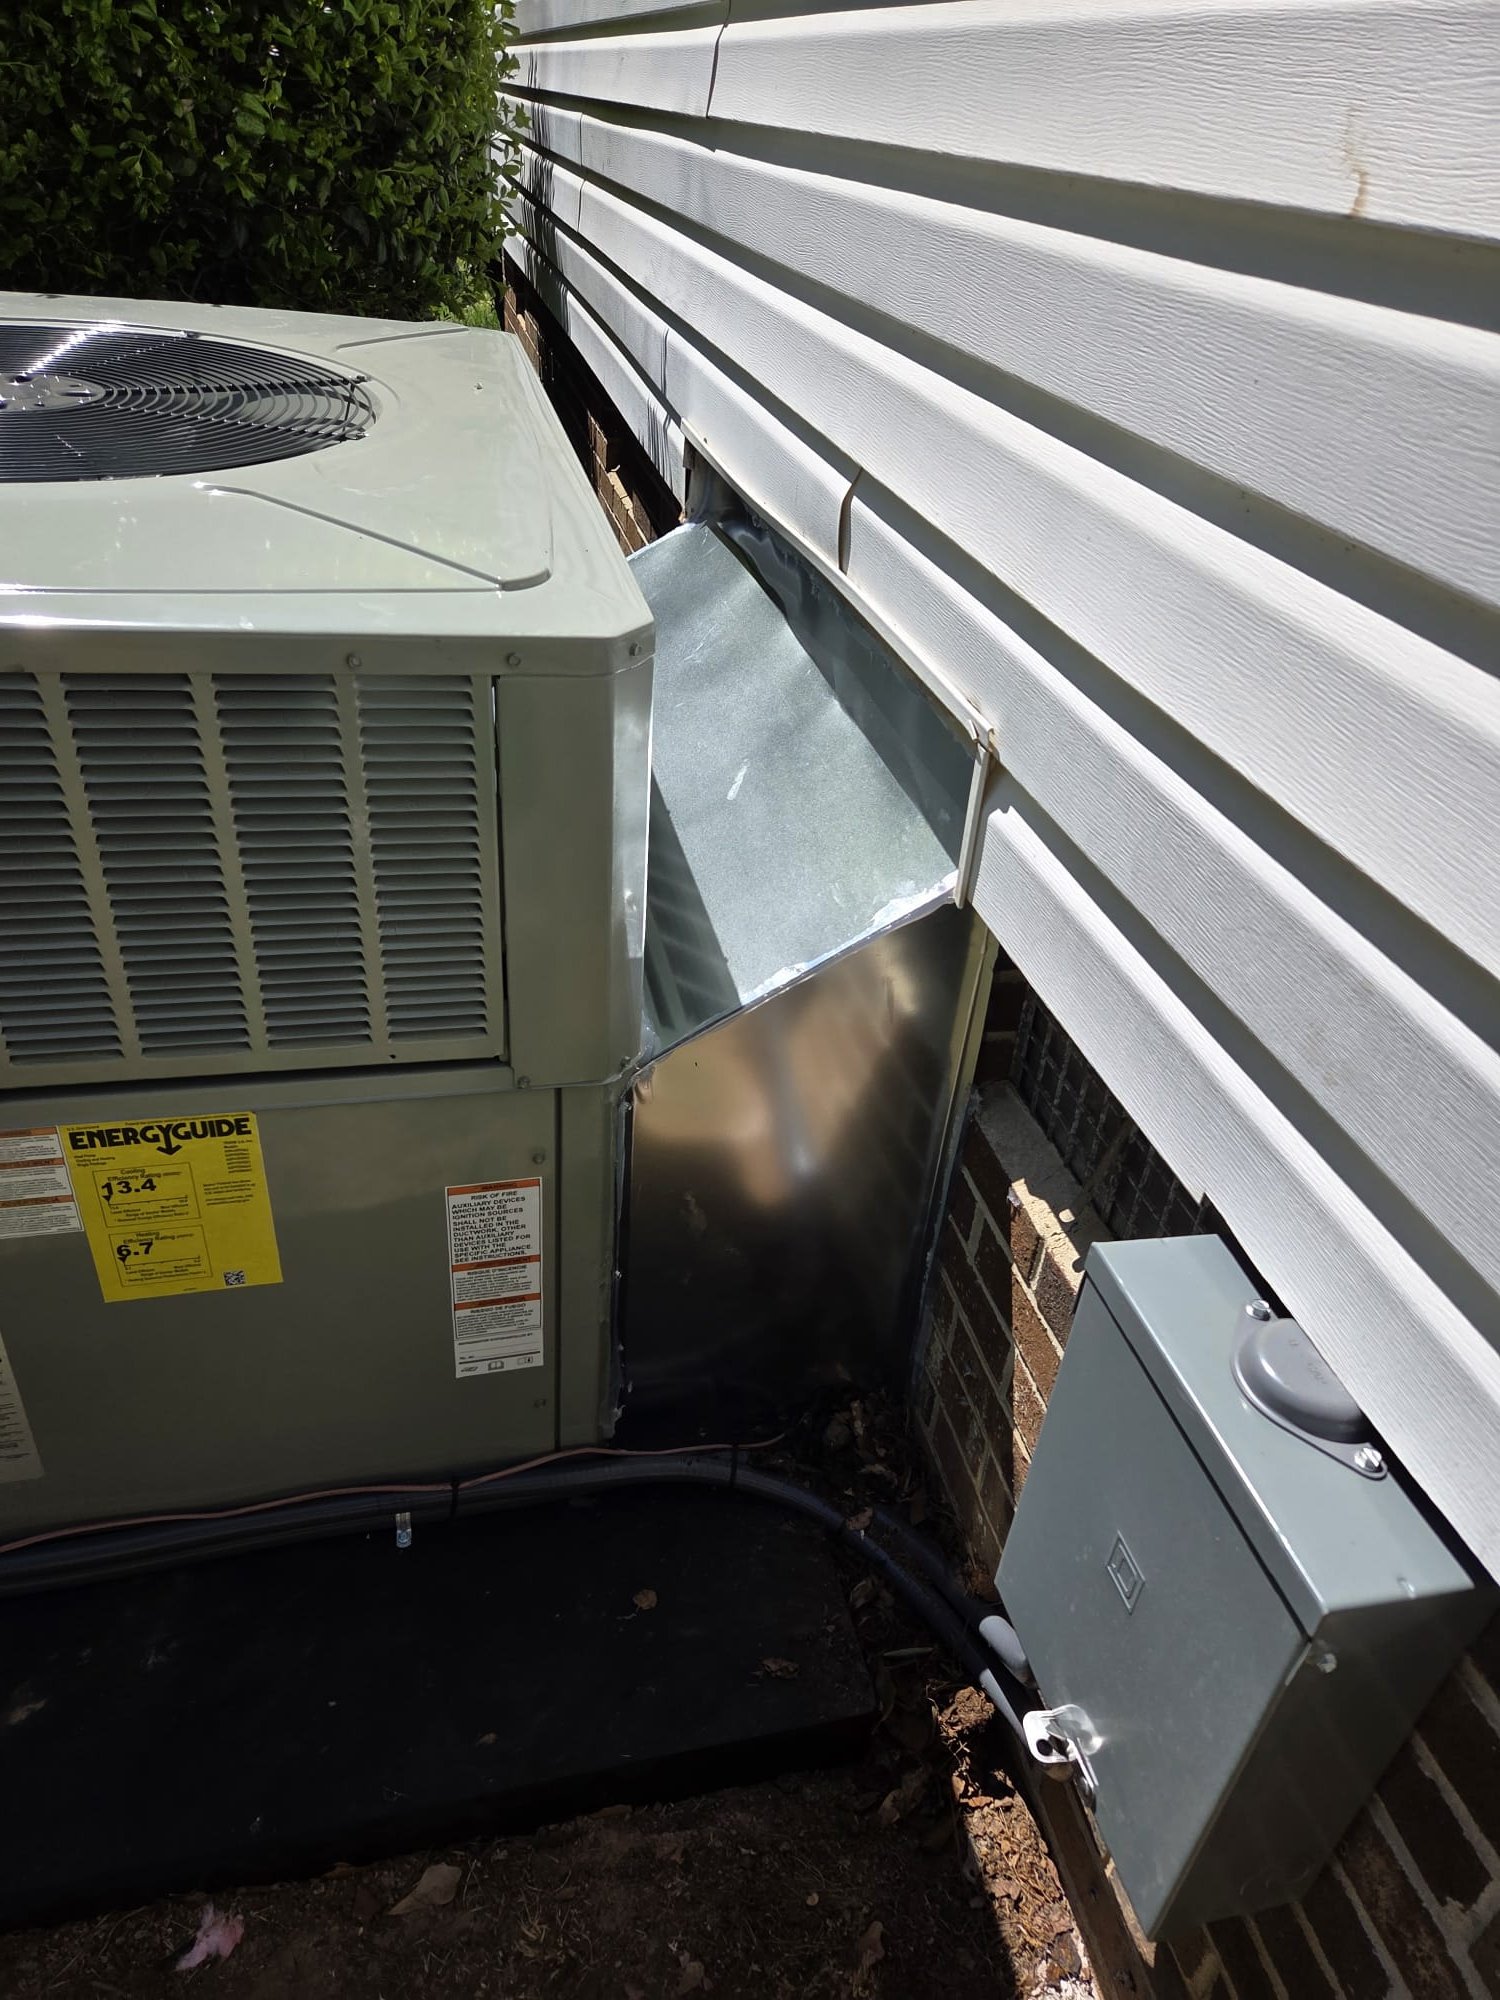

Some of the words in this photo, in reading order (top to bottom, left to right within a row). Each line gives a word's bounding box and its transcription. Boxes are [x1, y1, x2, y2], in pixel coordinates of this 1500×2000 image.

[69, 1118, 252, 1155] ENERGYGUIDE
[101, 1178, 157, 1196] 13.4
[452, 1201, 491, 1209] AUXILIARY
[488, 1208, 523, 1216] SOURCES
[453, 1223, 493, 1231] INSTALLED
[476, 1231, 514, 1239] AUXILIARY
[116, 1241, 153, 1257] 6.7
[490, 1244, 530, 1253] APPLIANCE
